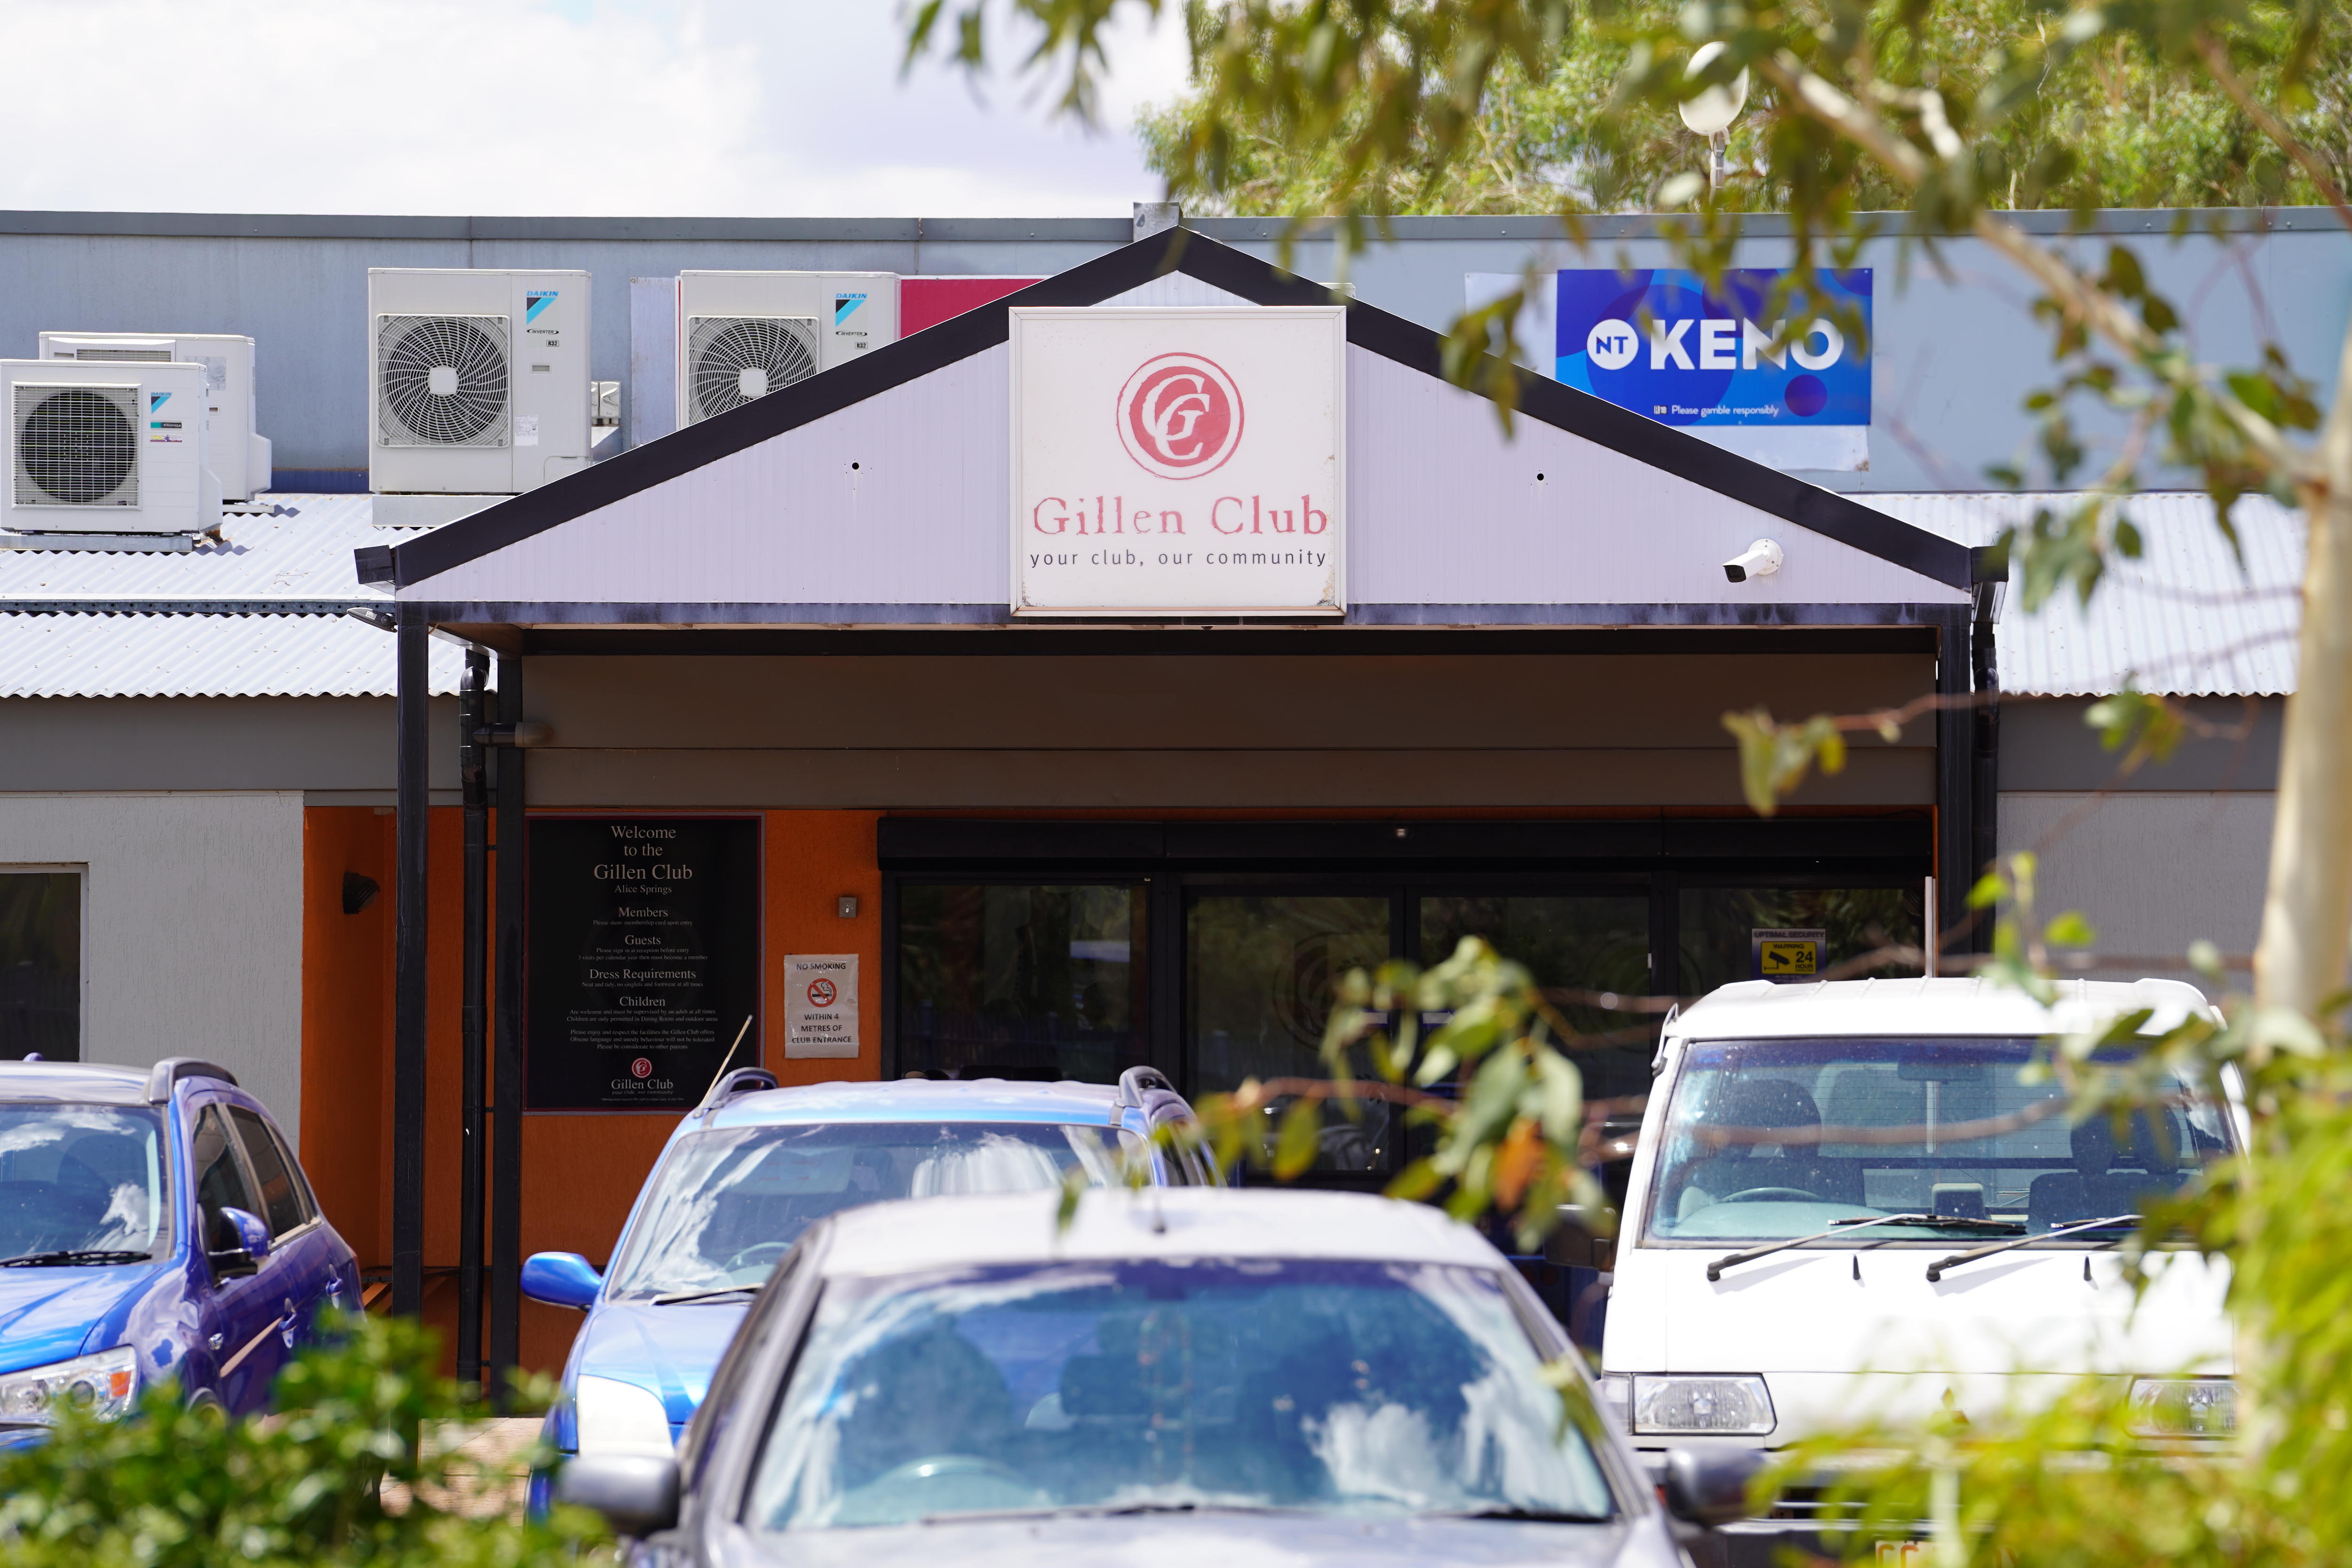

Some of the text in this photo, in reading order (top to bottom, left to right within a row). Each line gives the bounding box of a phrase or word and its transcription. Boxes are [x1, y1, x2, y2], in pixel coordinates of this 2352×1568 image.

[1597, 318, 1844, 370] NT KENO
[1672, 405, 1699, 414] Please
[1701, 405, 1730, 418] gamble
[1733, 405, 1779, 417] responsibly
[1034, 494, 1327, 535] Gillen Club
[1030, 549, 1326, 567] your club, our community
[611, 826, 676, 838] Welcome
[624, 843, 662, 856] to the
[594, 864, 692, 879] Gillen Club
[640, 885, 672, 895] Springs
[619, 907, 668, 916] Members
[625, 935, 660, 945] Guests
[1796, 951, 1813, 963] 24
[590, 969, 696, 981] Dress Requirements
[620, 996, 665, 1006] Children
[612, 1079, 673, 1089] Gillen Club
